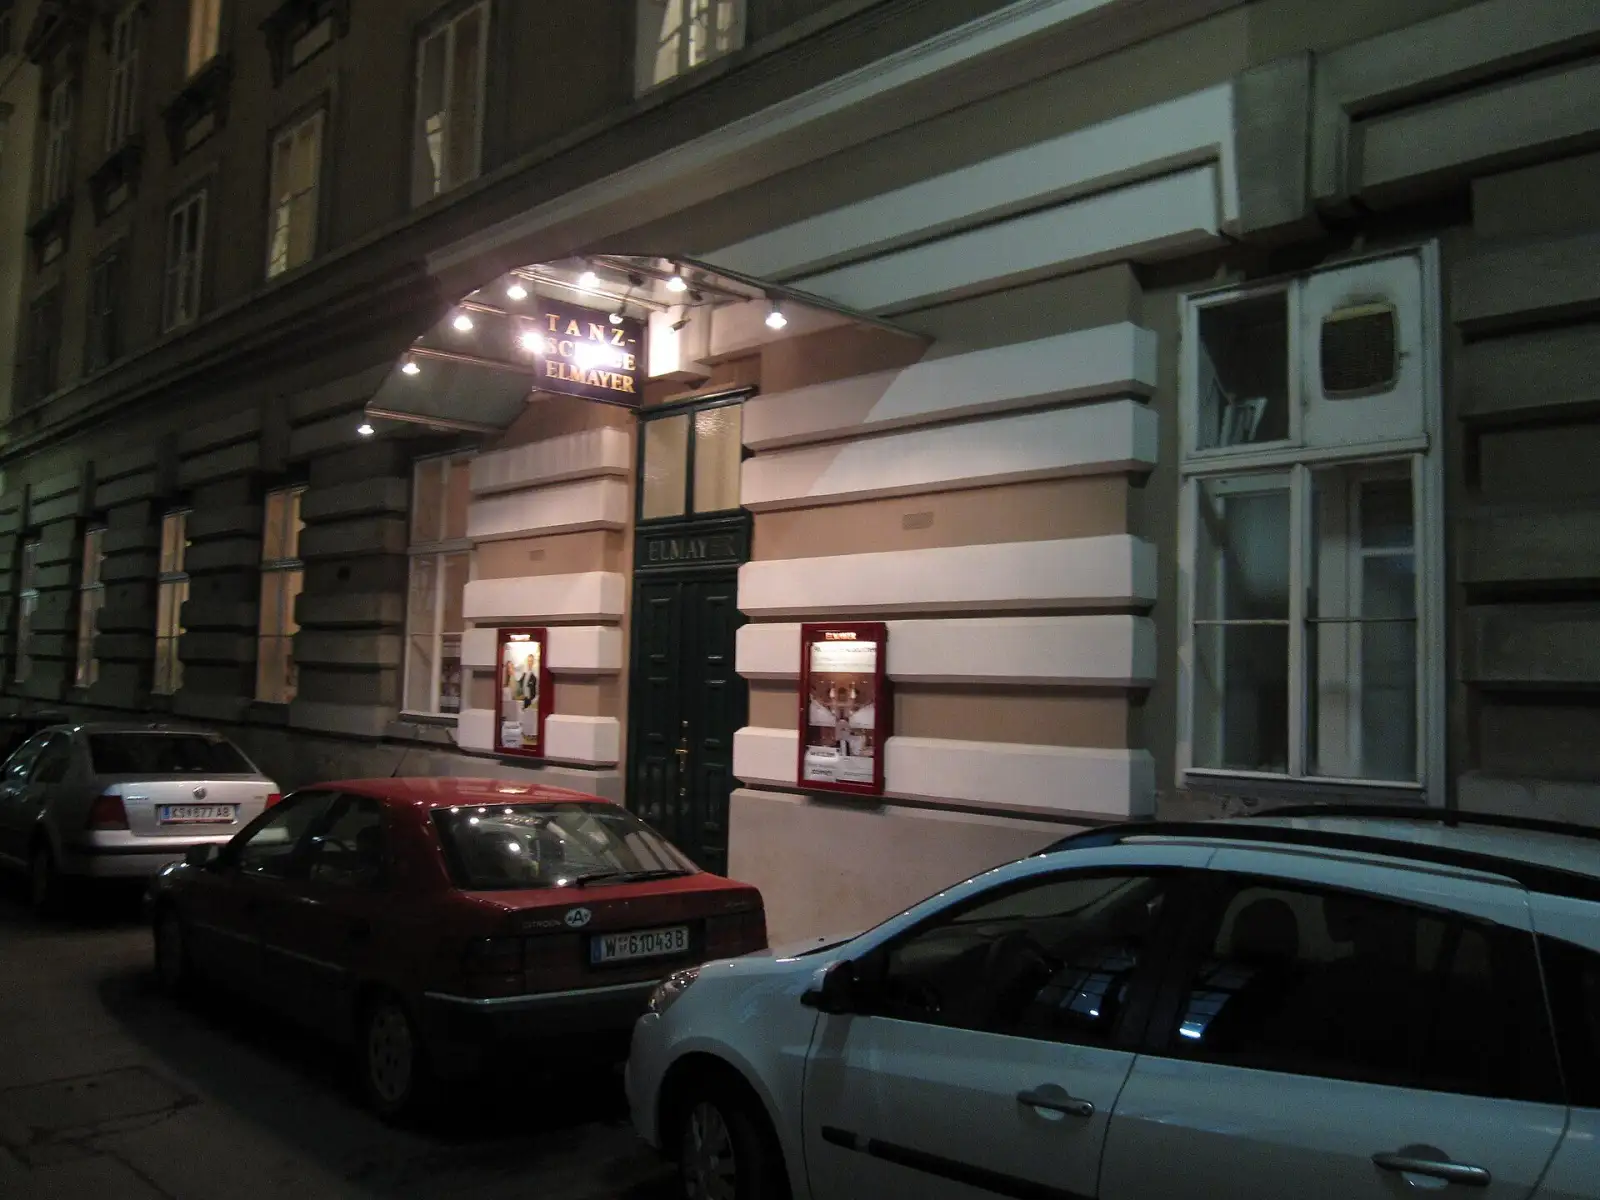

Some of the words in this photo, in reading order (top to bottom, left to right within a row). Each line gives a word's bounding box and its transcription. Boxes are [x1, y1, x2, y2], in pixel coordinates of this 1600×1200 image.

[545, 313, 636, 346] TANZ-
[545, 337, 636, 371] SCE
[545, 359, 637, 393] ELMAYER
